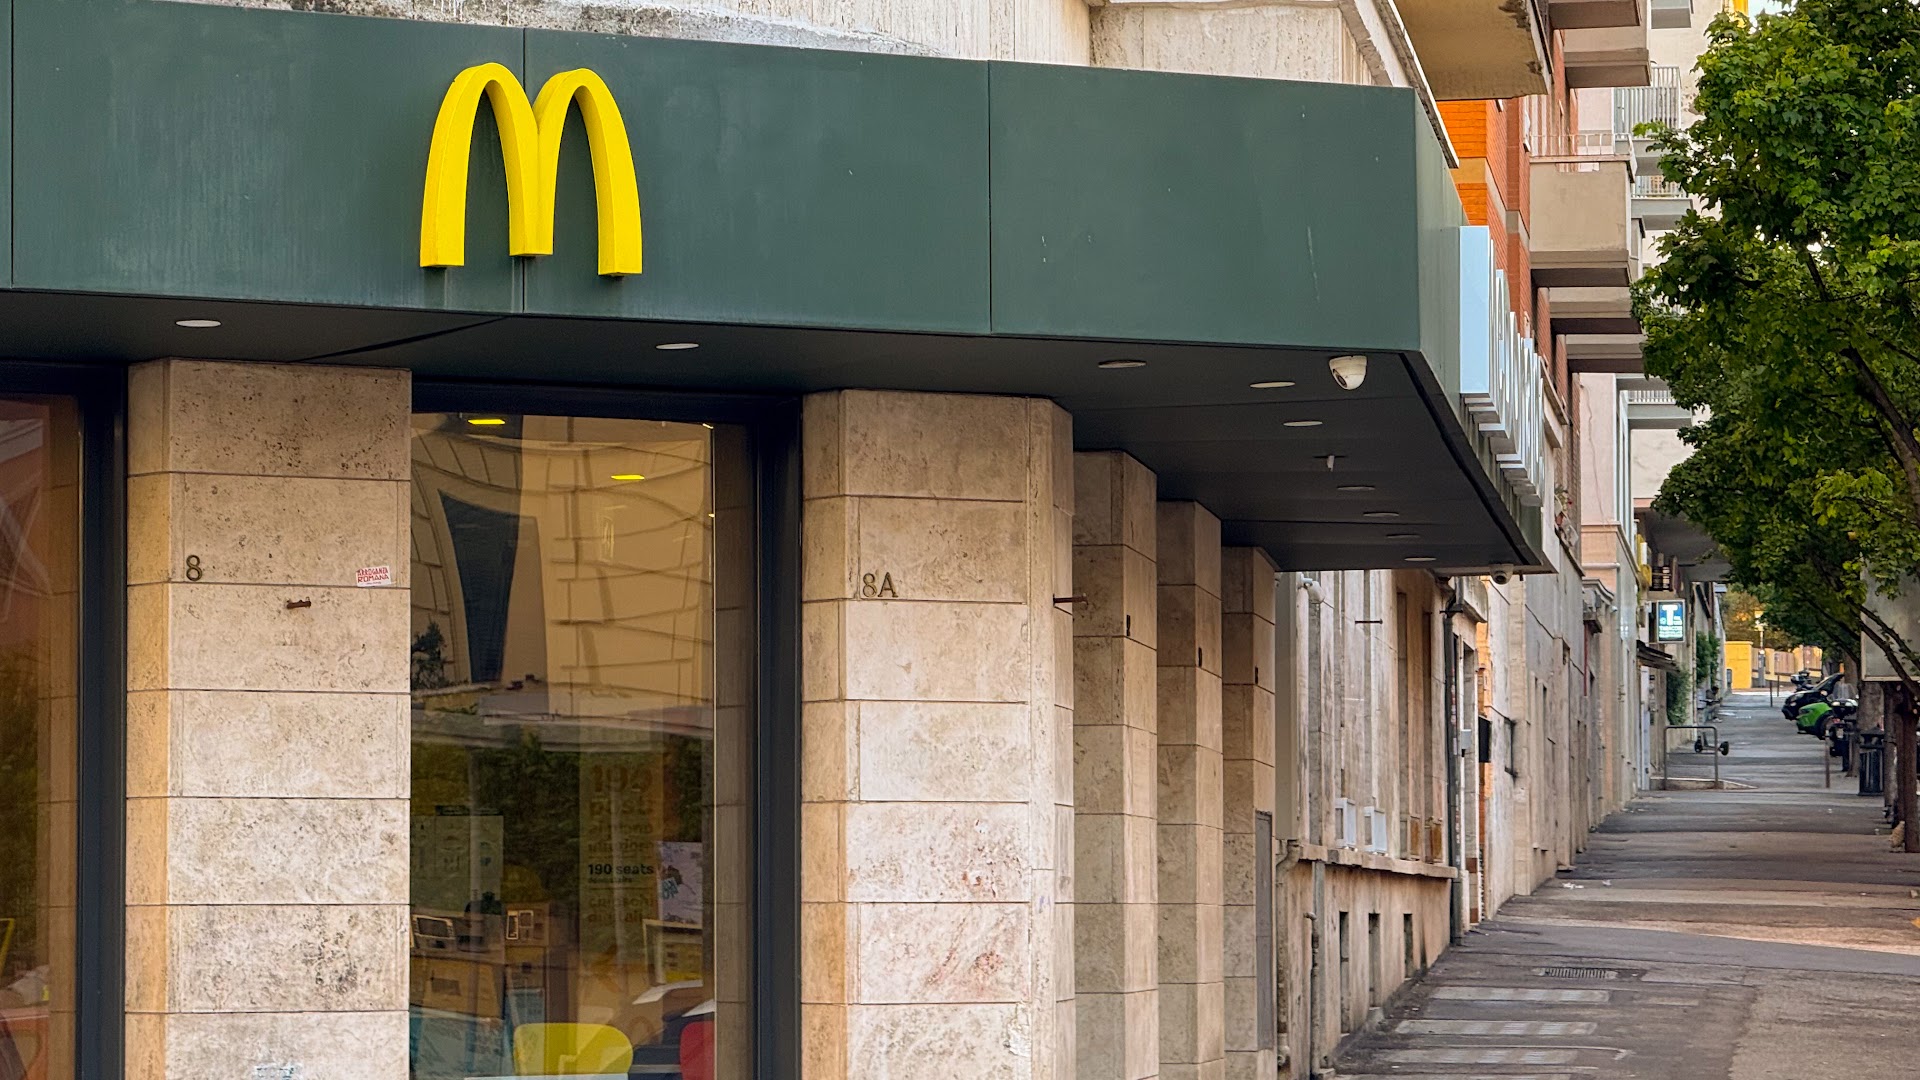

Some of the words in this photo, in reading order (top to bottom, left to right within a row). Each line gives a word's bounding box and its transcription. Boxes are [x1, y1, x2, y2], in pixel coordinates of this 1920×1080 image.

[186, 554, 203, 582] 8
[358, 574, 390, 583] ROMANA
[863, 571, 899, 598] 8A
[1662, 604, 1678, 626] T
[588, 863, 612, 875] 190
[615, 863, 655, 875] seats
